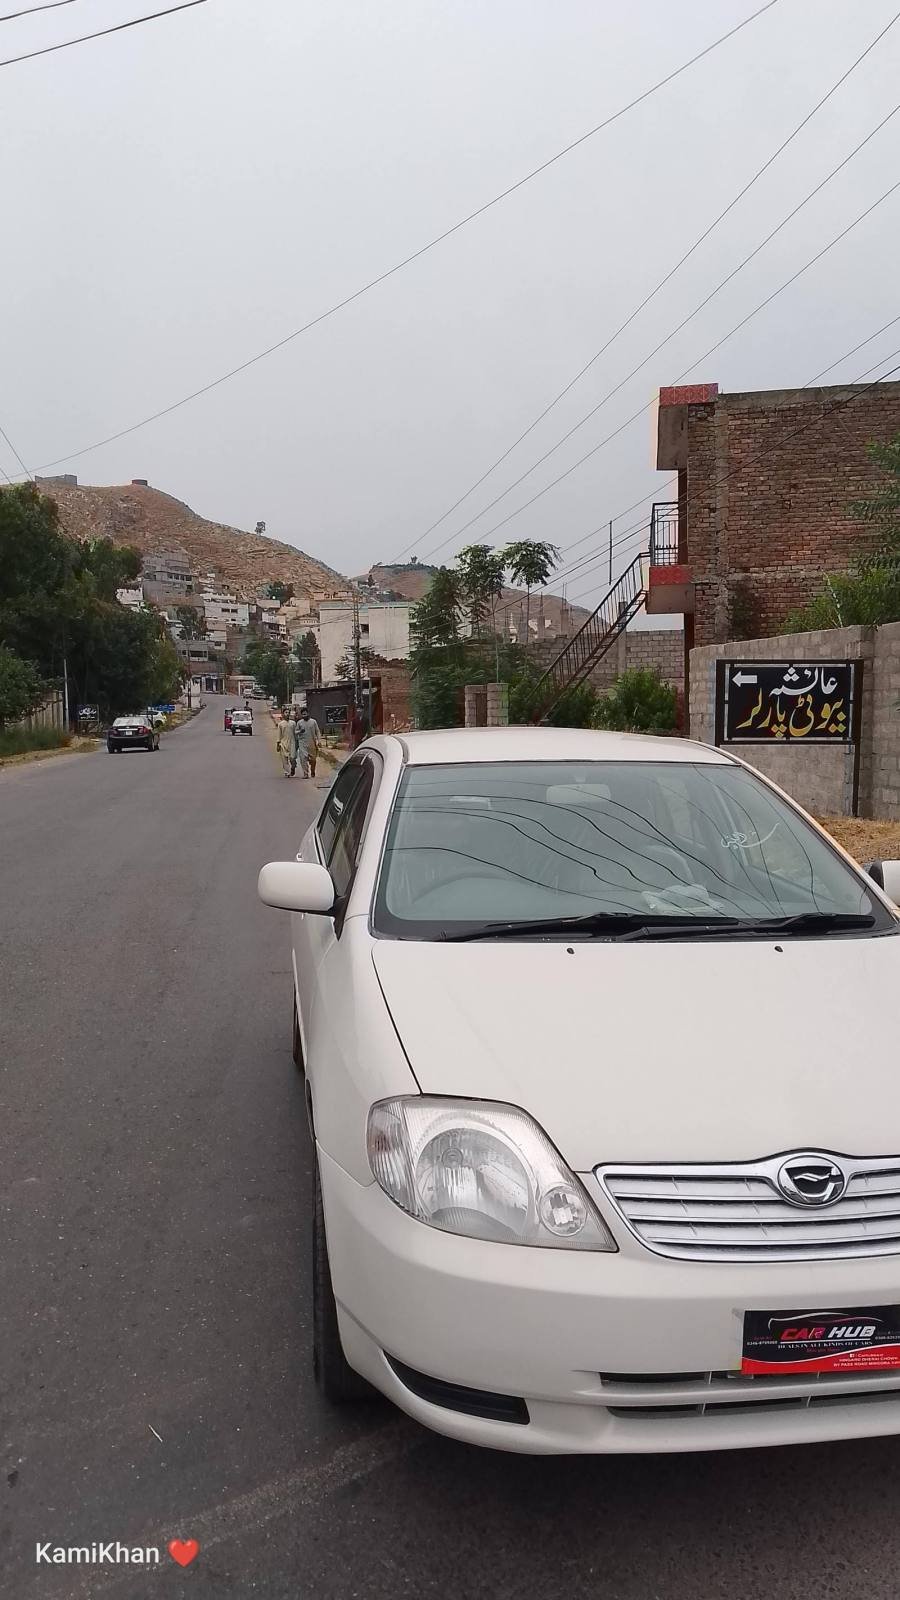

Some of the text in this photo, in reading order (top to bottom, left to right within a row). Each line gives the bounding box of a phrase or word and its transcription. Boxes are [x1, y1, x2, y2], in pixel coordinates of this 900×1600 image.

[769, 666, 838, 697] عائشہ
[736, 688, 846, 737] بیوٹی پارلر
[780, 1326, 876, 1340] CAR HUB
